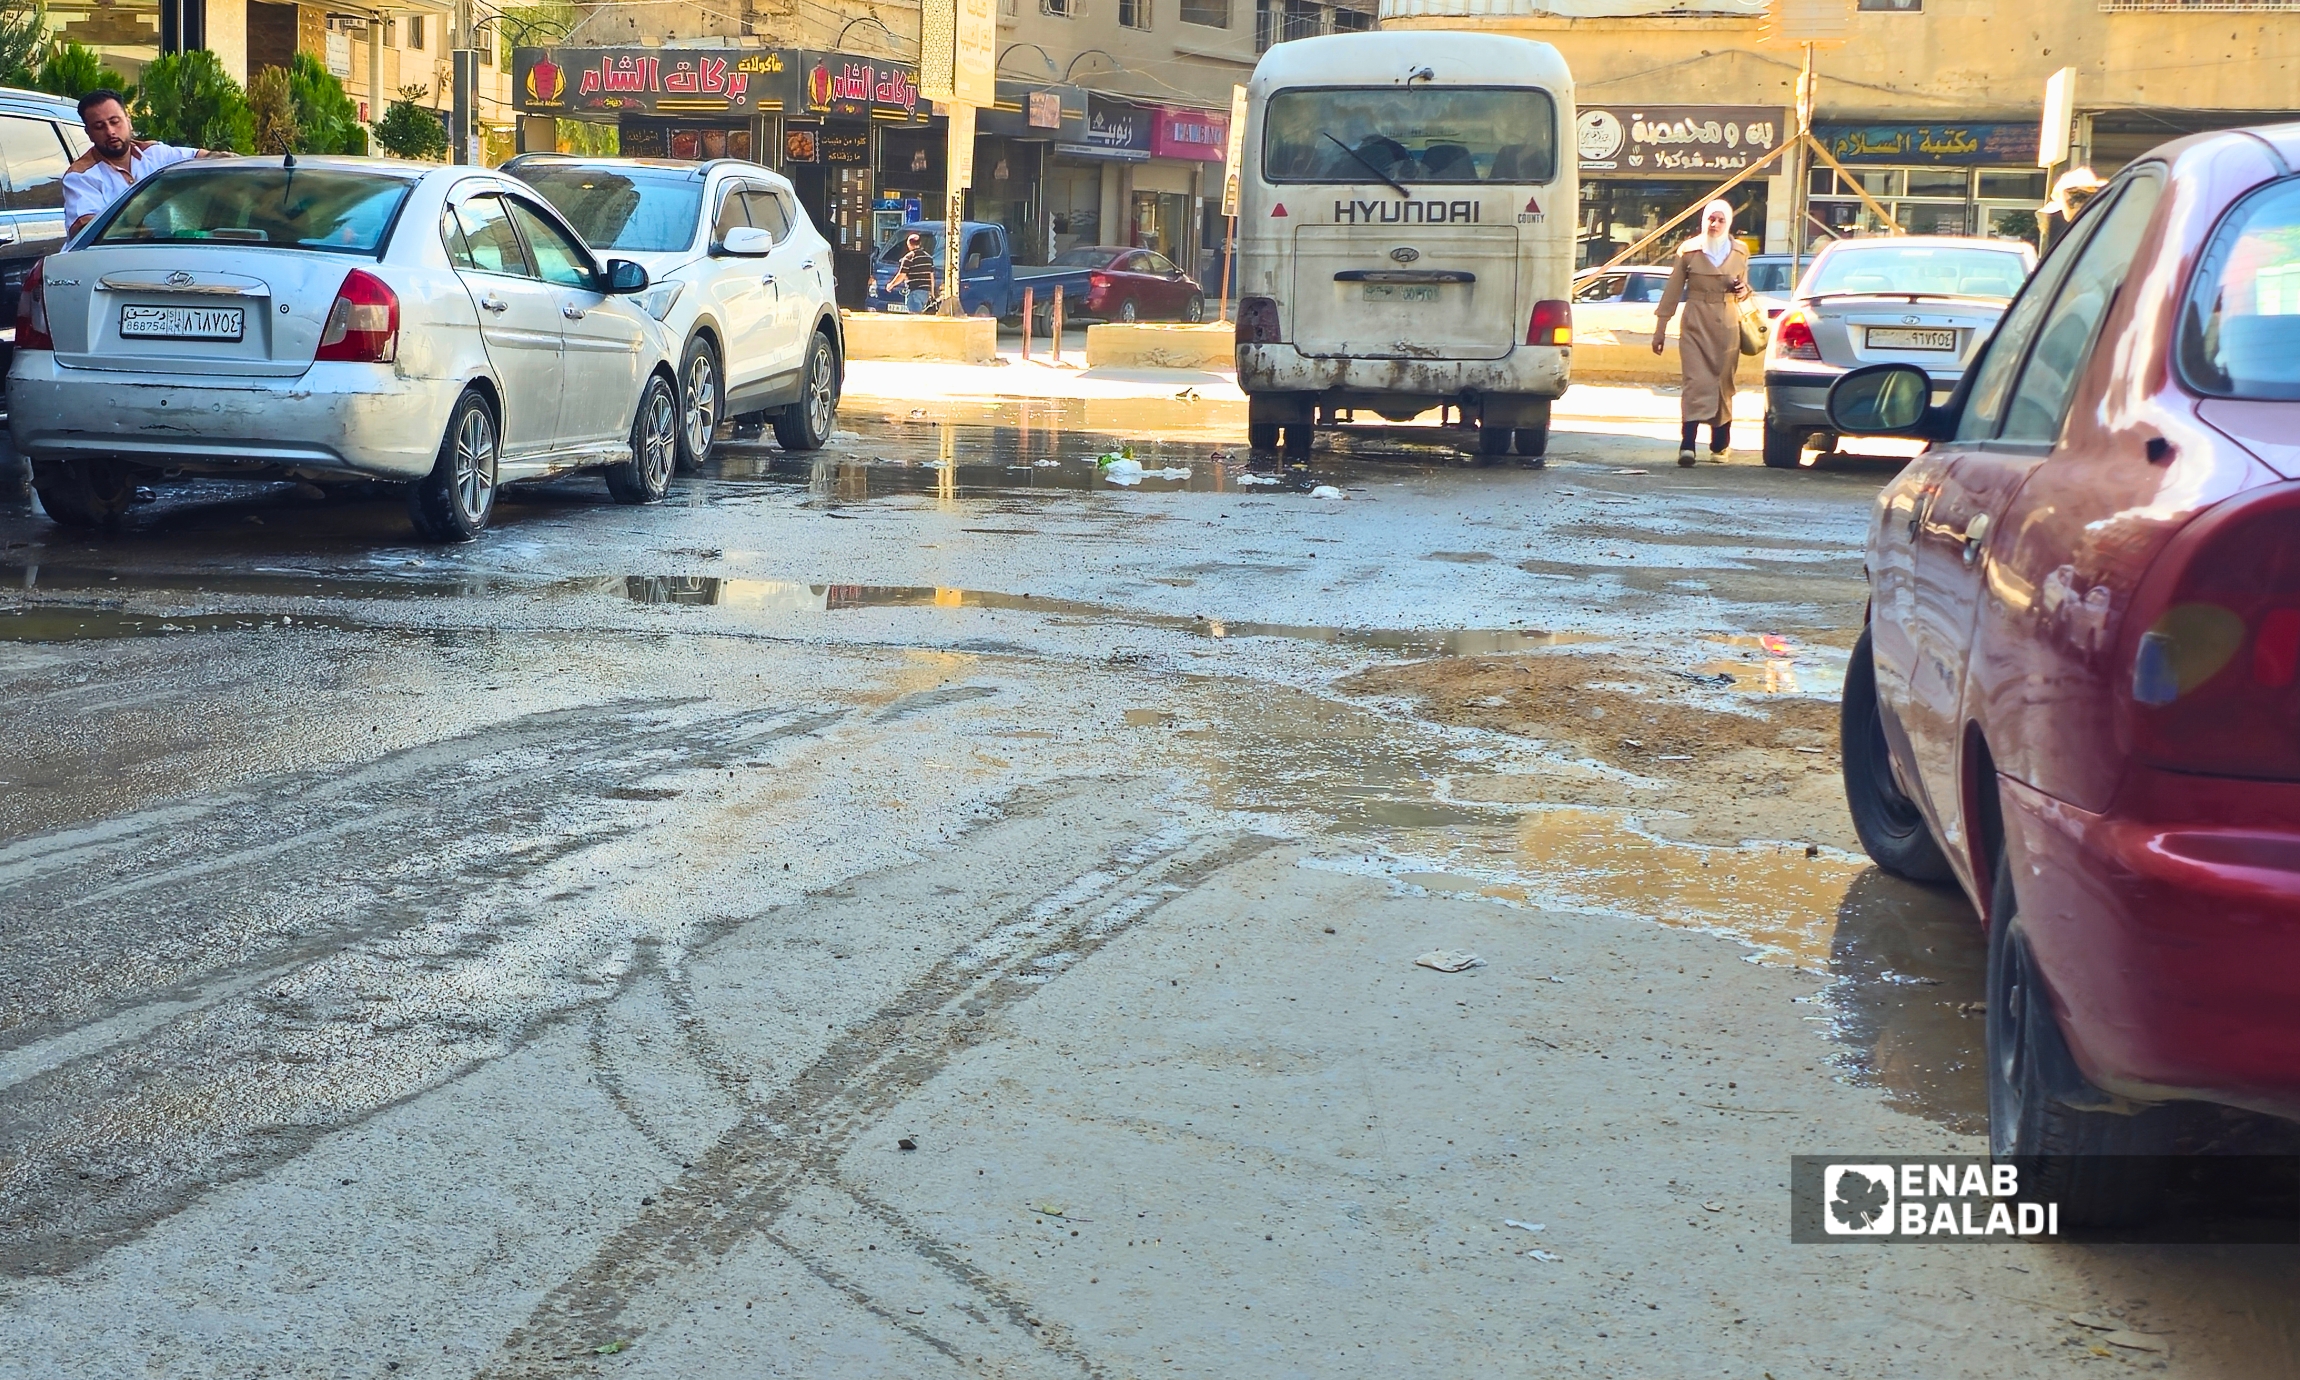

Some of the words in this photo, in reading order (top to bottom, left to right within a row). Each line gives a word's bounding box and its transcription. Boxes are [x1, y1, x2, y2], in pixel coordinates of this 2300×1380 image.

[579, 56, 660, 95] الشام
[738, 52, 784, 74] مأكولات
[664, 56, 749, 105] بركات
[832, 63, 874, 101] الشام
[876, 69, 917, 115] بركات
[1834, 127, 1911, 161] السلام
[1919, 127, 1978, 160] مكتبة
[1335, 200, 1480, 223] HYUNDAI
[1517, 213, 1545, 224] COUNTY
[126, 308, 166, 321] دمشق
[126, 320, 167, 332] 868754
[184, 311, 239, 333] ٨٦٨٧٥٤
